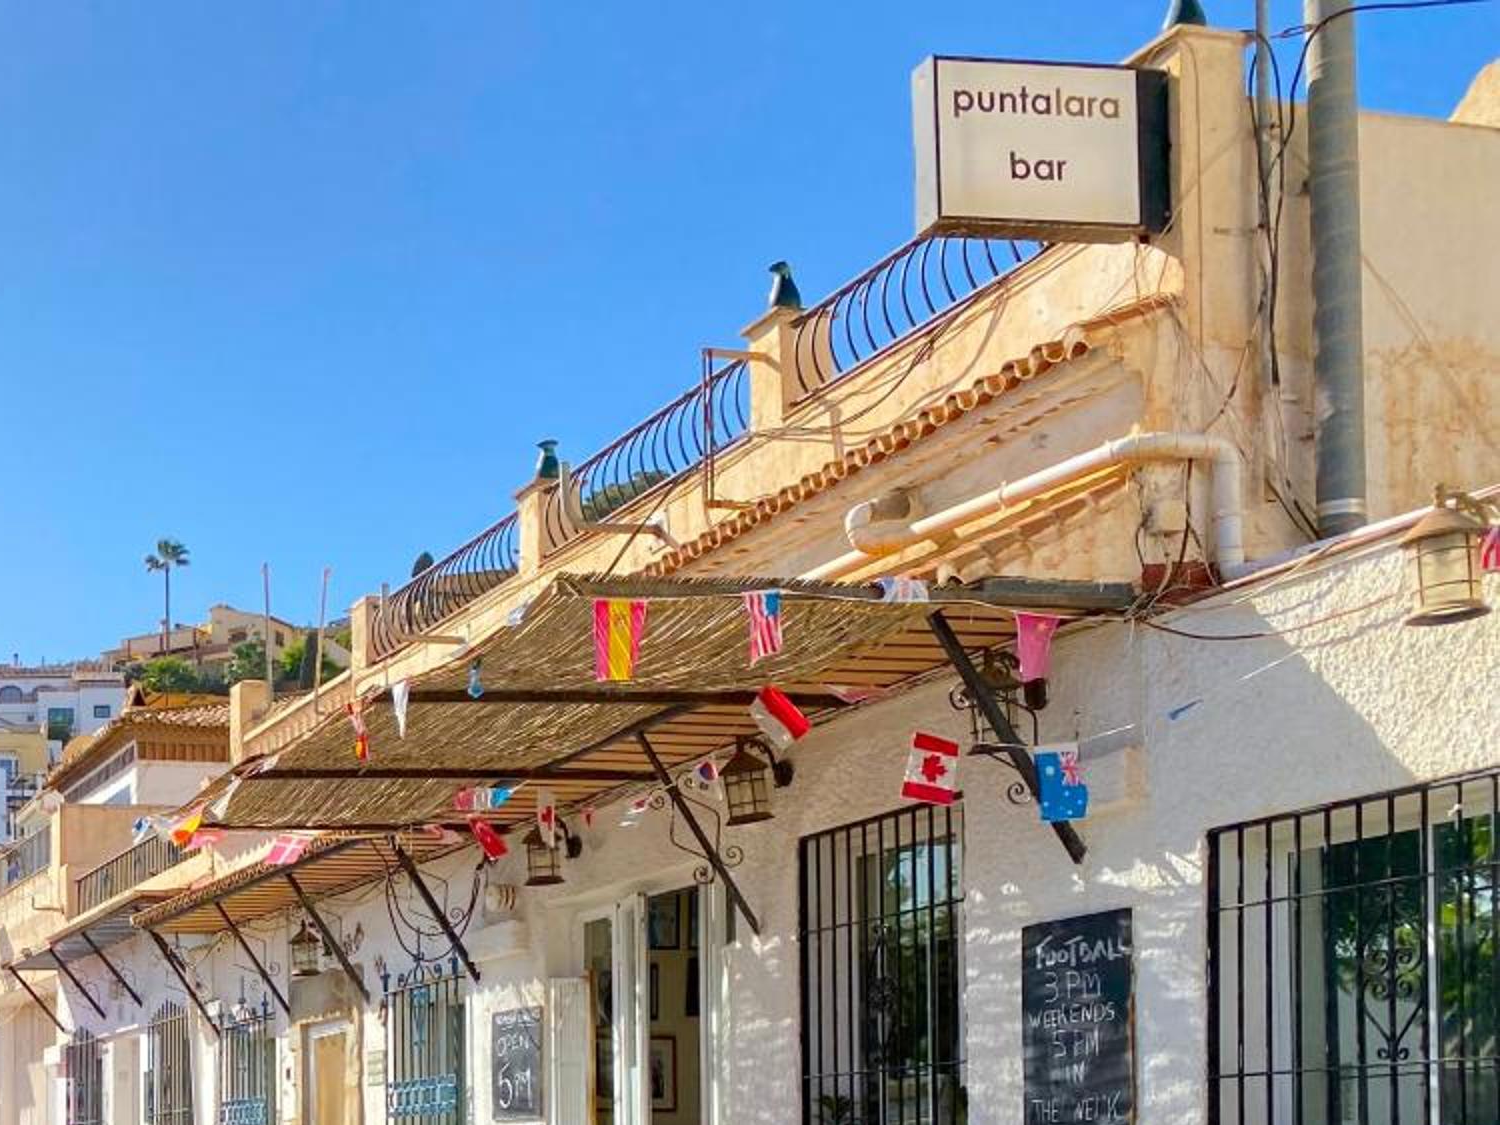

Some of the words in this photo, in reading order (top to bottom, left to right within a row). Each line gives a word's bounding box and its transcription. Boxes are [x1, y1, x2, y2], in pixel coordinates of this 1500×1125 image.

[953, 86, 1120, 119] puntalara
[1010, 151, 1067, 181] bar
[1036, 935, 1126, 968] FOOTBALL
[1045, 971, 1059, 1003] 3
[1065, 970, 1101, 998] PM
[1027, 1002, 1116, 1029] WEEKENDS
[1052, 1029, 1067, 1057] 5
[1031, 1098, 1060, 1123] THE
